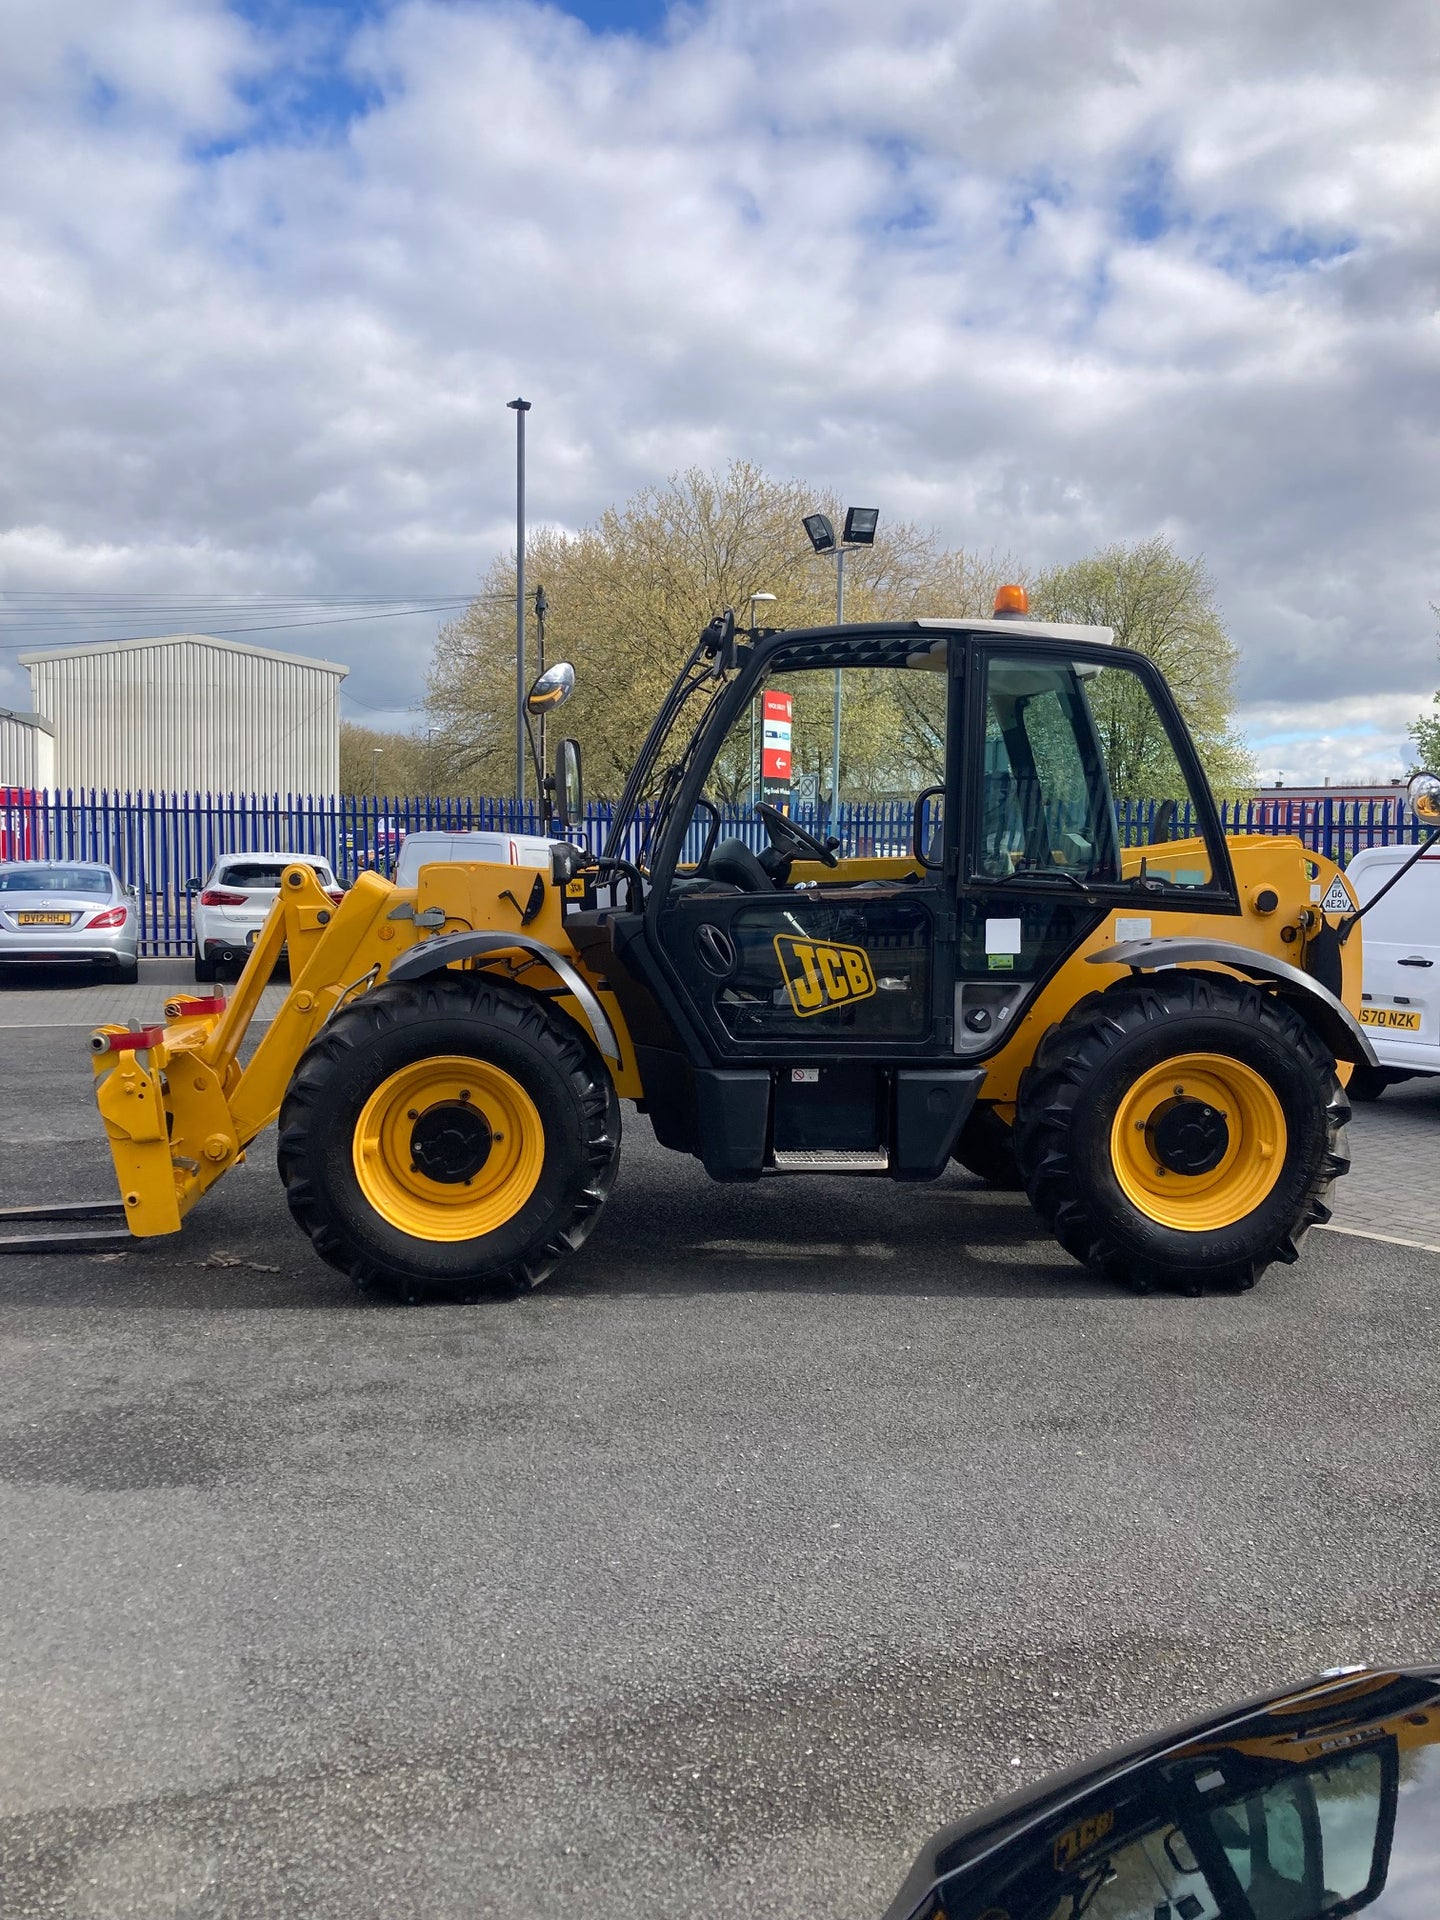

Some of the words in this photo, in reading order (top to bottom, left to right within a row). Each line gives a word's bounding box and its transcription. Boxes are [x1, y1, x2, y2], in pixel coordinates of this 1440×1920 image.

[1325, 899, 1348, 909] AE2V
[24, 914, 45, 922] DV12
[48, 914, 66, 922] HHJ
[792, 943, 869, 1008] JCB
[1358, 1009, 1387, 1024] S70
[1388, 1012, 1415, 1028] NZK
